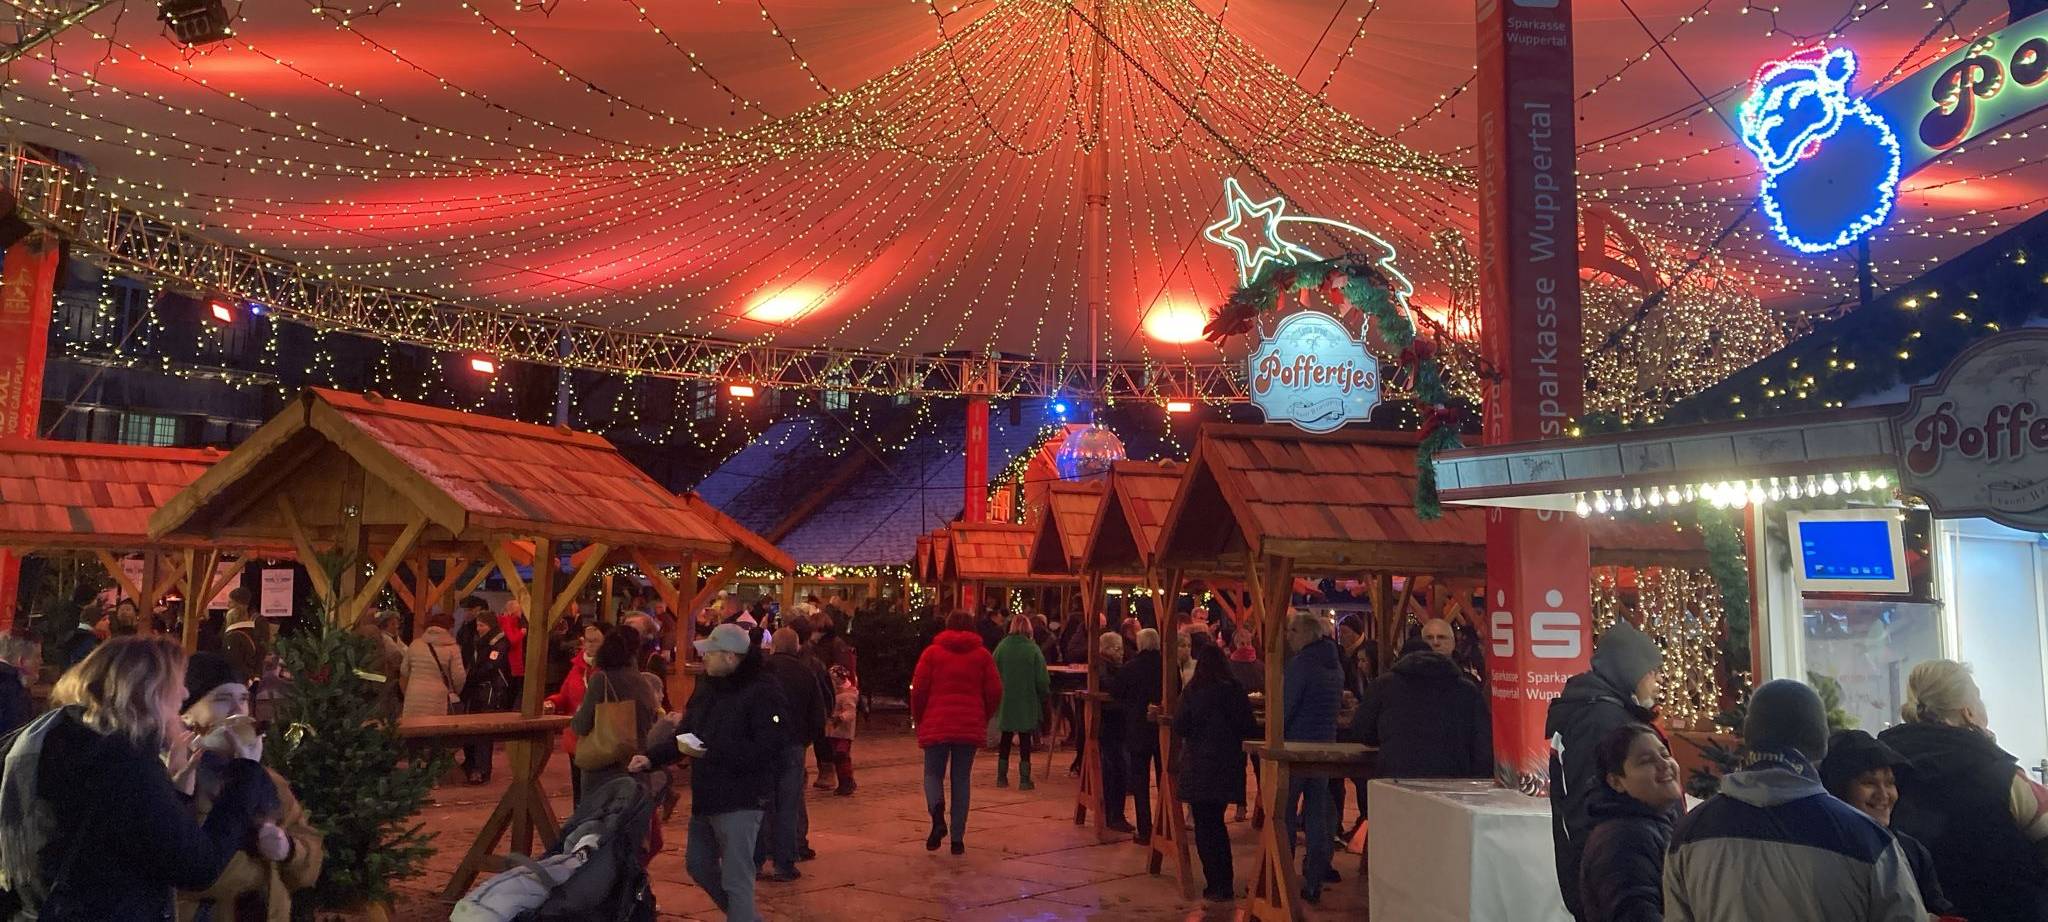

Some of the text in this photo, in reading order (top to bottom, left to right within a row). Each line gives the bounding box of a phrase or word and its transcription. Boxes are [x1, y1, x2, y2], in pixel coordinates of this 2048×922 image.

[1507, 17, 1566, 32] Sparkasse
[1507, 32, 1567, 47] Wuppertal
[1919, 37, 2048, 150] Po
[1524, 102, 1560, 262] Wuppertal
[1254, 349, 1376, 395] Poffertjes
[1907, 401, 2048, 474] Poffe
